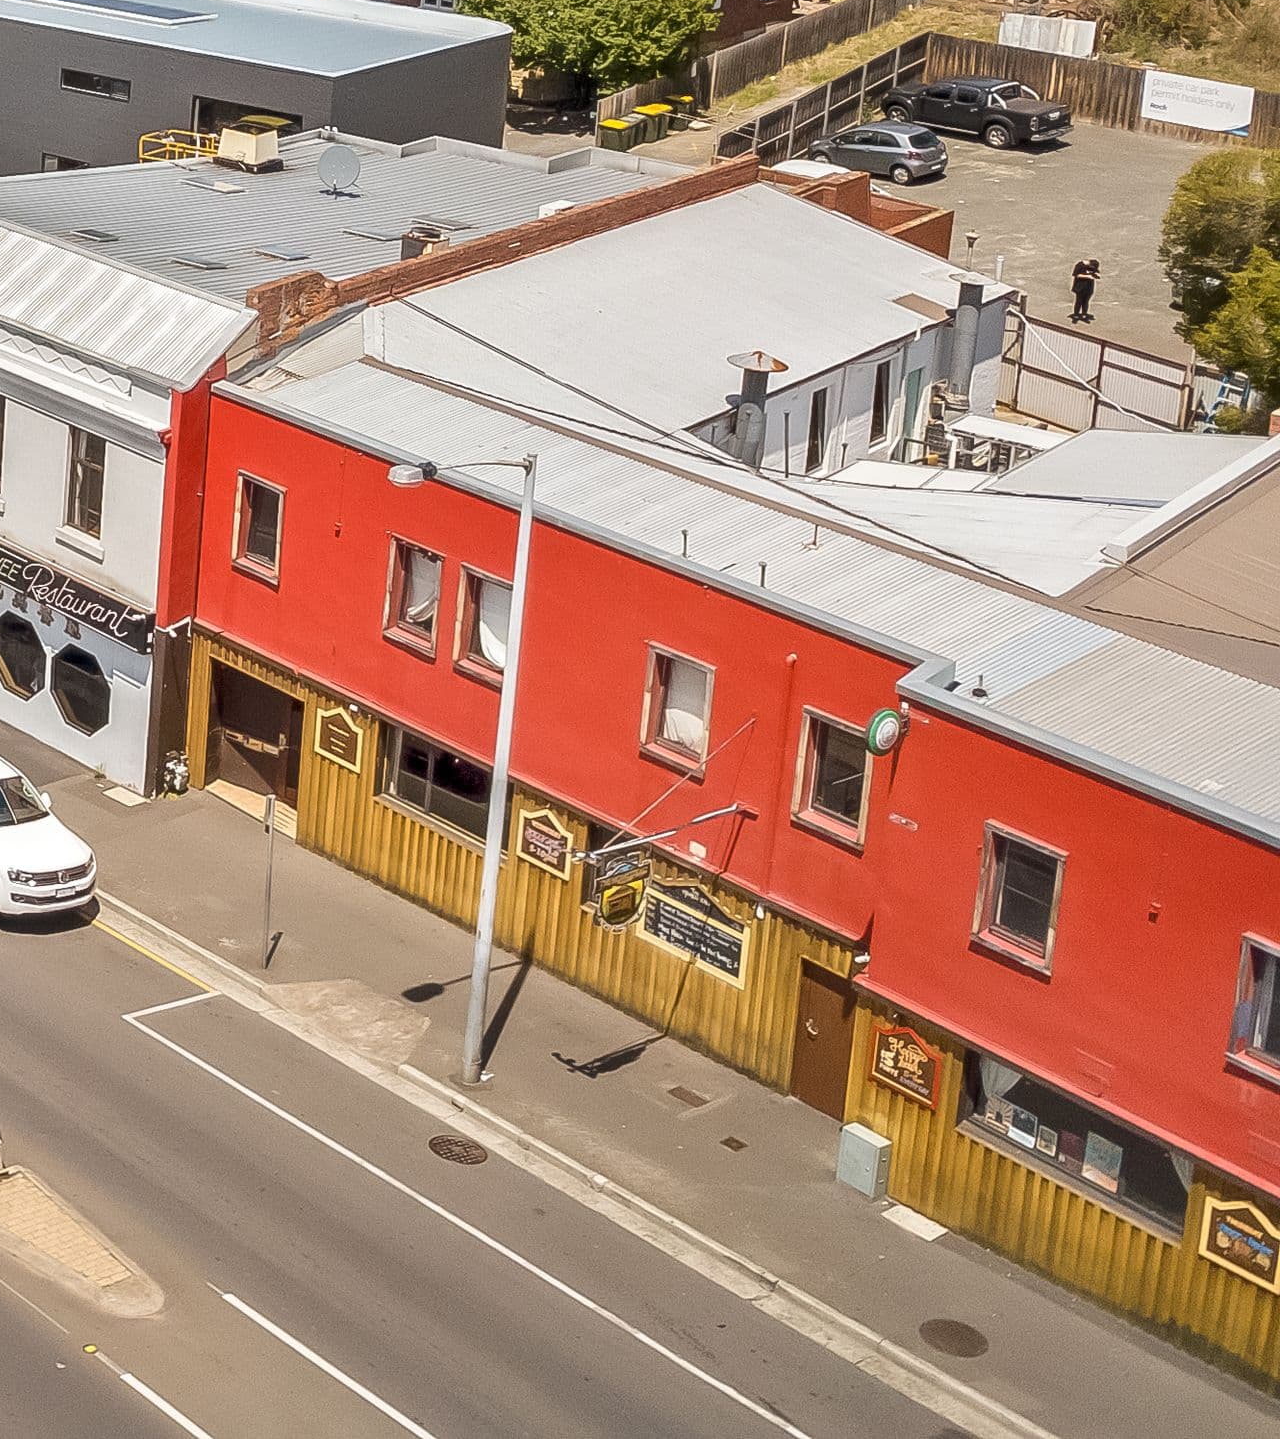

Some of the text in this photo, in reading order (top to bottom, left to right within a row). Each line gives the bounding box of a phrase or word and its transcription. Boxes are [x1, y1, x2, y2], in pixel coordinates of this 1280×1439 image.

[1152, 78, 1220, 97] private car park
[1216, 99, 1236, 113] only
[23, 562, 139, 638] Restaurant
